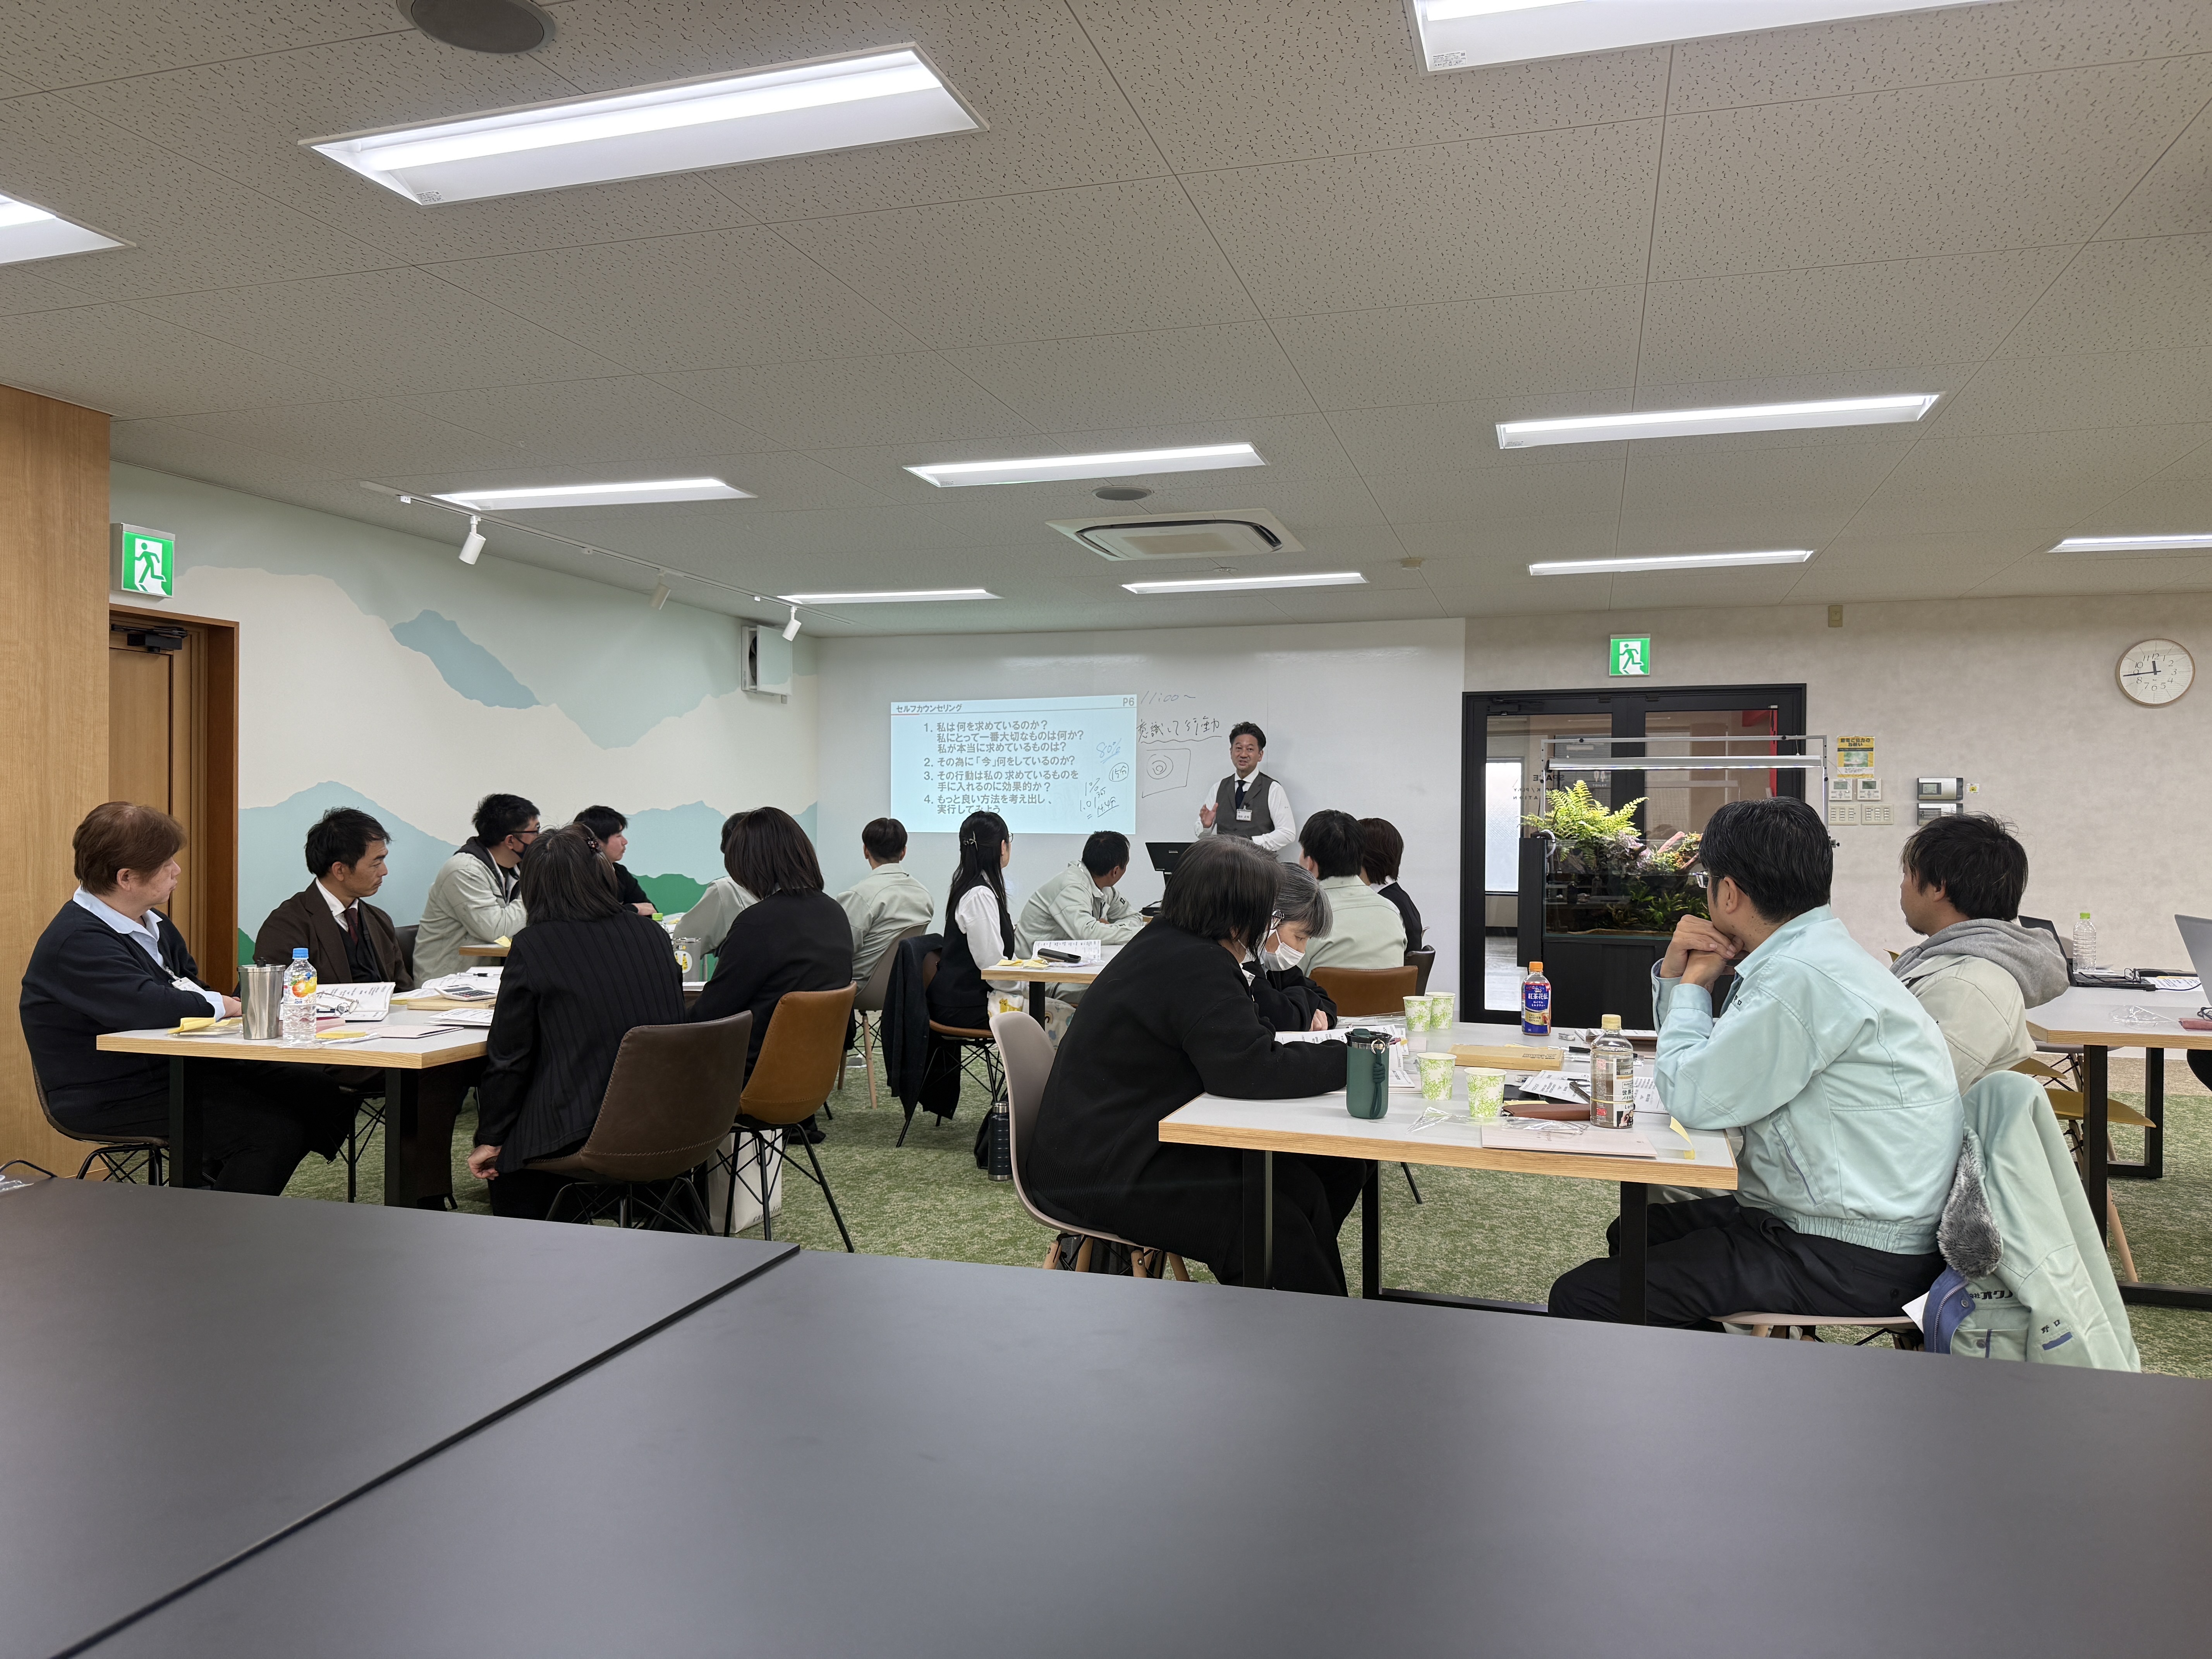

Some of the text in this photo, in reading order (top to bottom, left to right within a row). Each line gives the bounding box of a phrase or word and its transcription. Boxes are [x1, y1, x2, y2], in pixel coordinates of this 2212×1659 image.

[1123, 697, 1134, 706] P6
[896, 704, 962, 713] セルフカウンセリング
[924, 720, 1048, 732] 1. 私は何を求めているのか？
[937, 730, 1084, 743] 私にとって一番大切なものは何か?
[938, 742, 1066, 753] 私が本当に求めているものは?
[1096, 738, 1121, 758] 80%
[924, 757, 933, 767] 2.
[924, 771, 933, 780] 3.
[938, 781, 1051, 792] 手に入れるのに効果的か？
[1085, 778, 1100, 796] 1%
[924, 794, 1051, 804] 4. もっと良い方法を考え出し、
[2041, 1319, 2060, 1334] 野口
